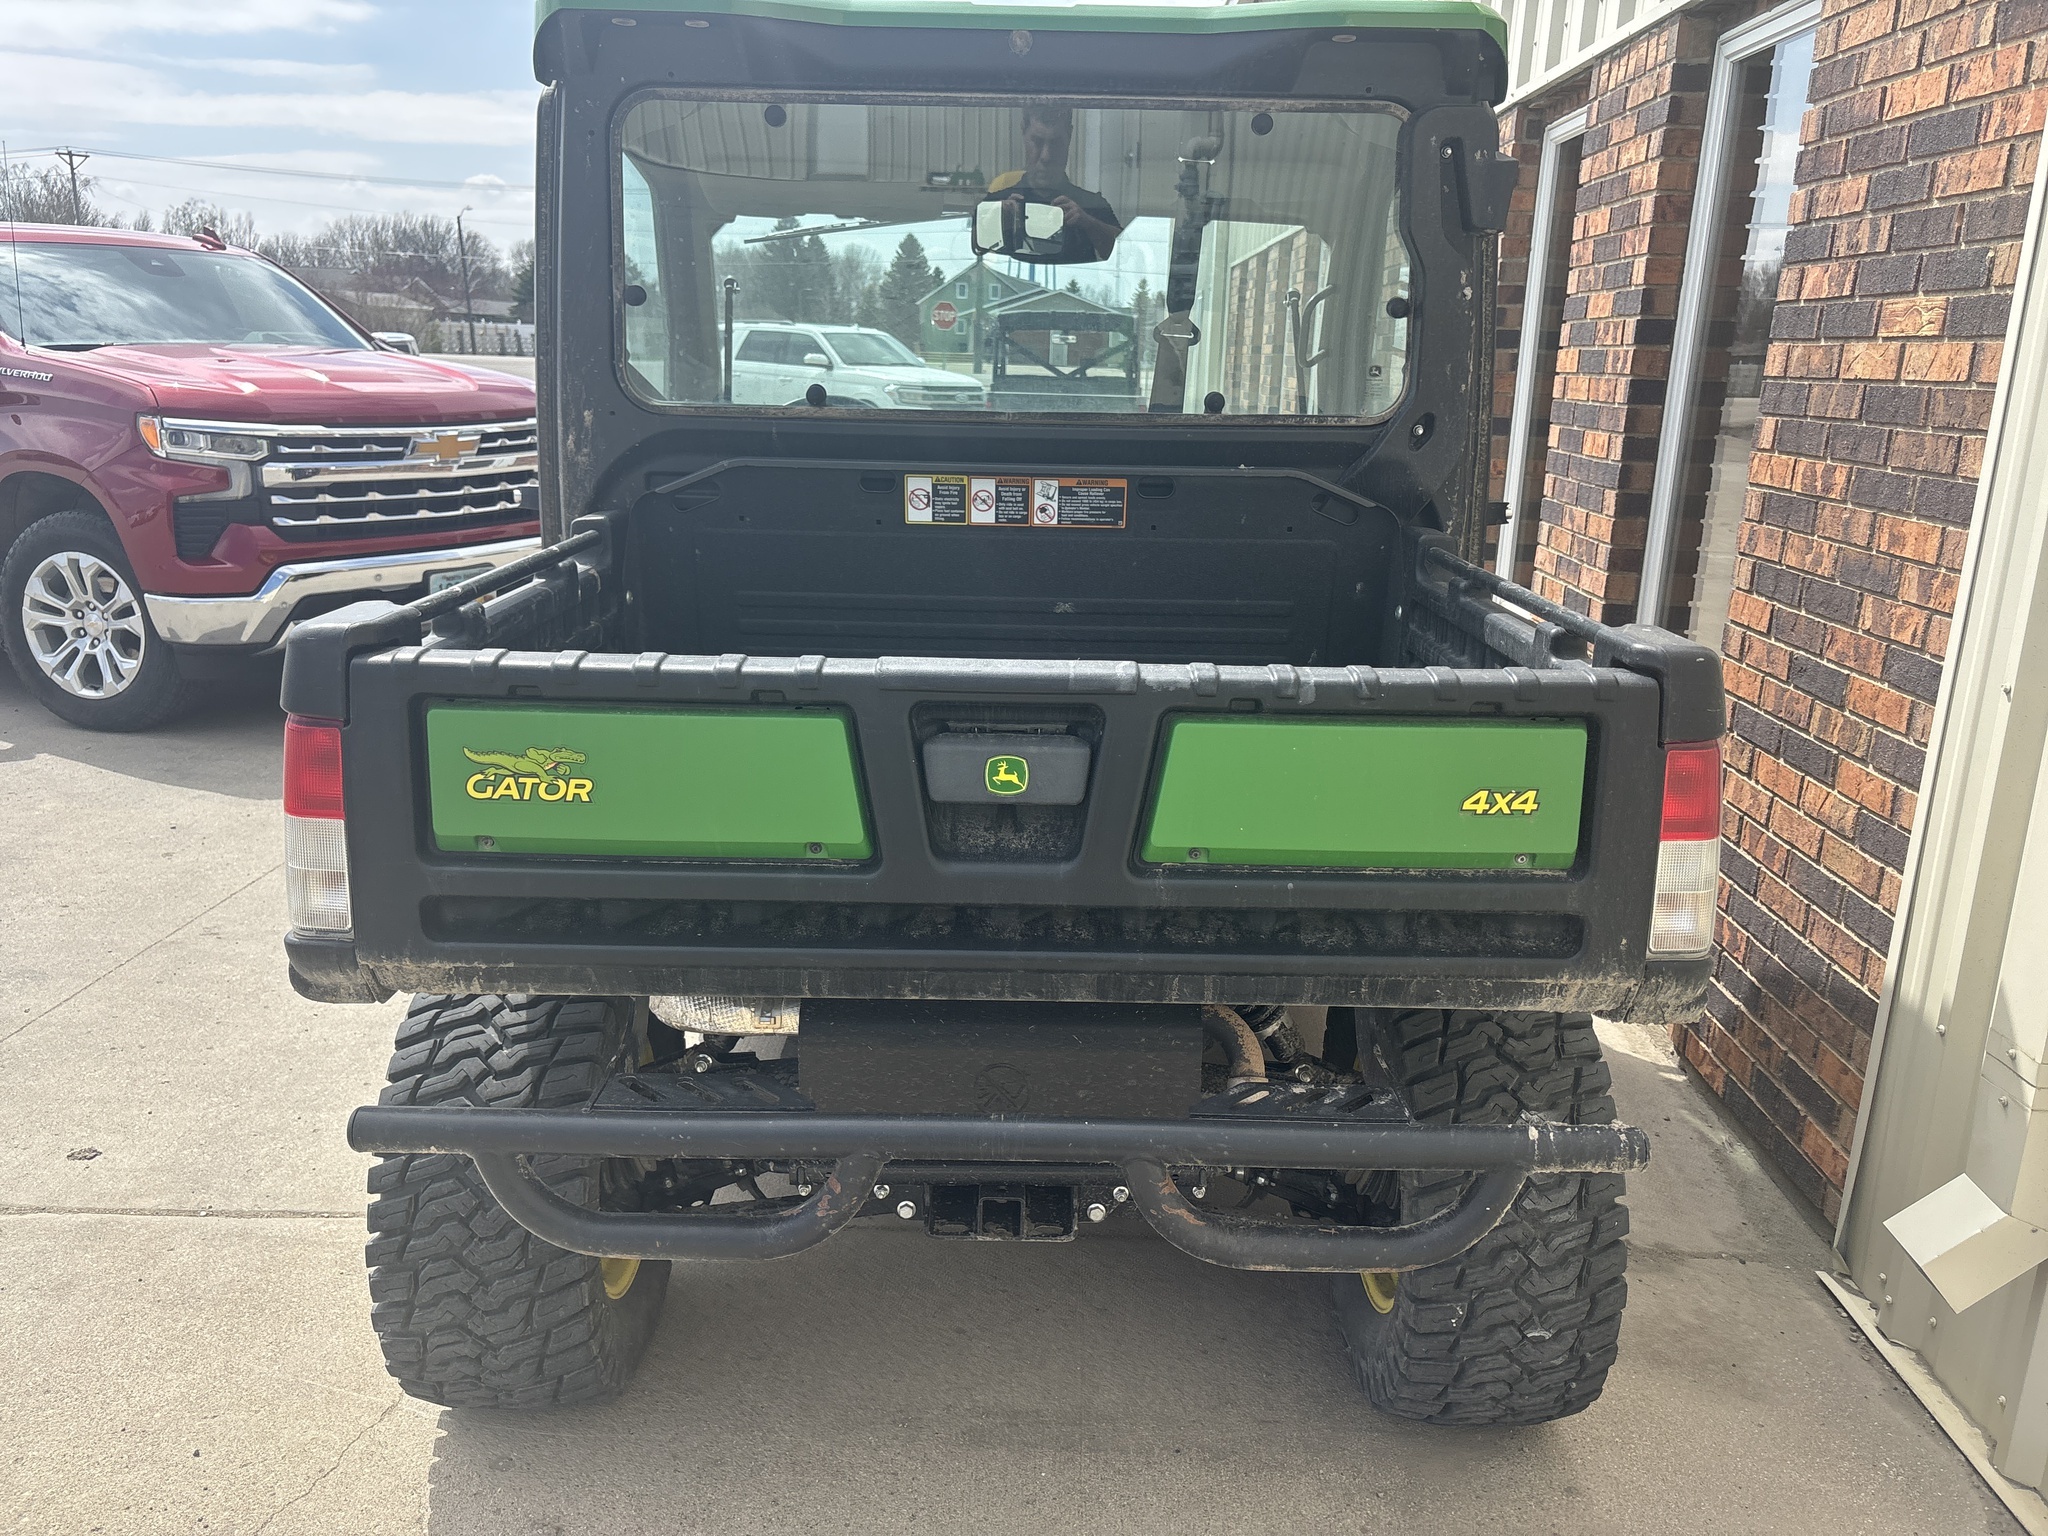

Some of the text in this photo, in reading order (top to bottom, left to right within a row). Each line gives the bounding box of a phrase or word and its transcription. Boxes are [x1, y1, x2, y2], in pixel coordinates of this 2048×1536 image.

[933, 310, 956, 322] STOP
[466, 774, 592, 803] GATOR
[1460, 789, 1540, 815] 4x4
